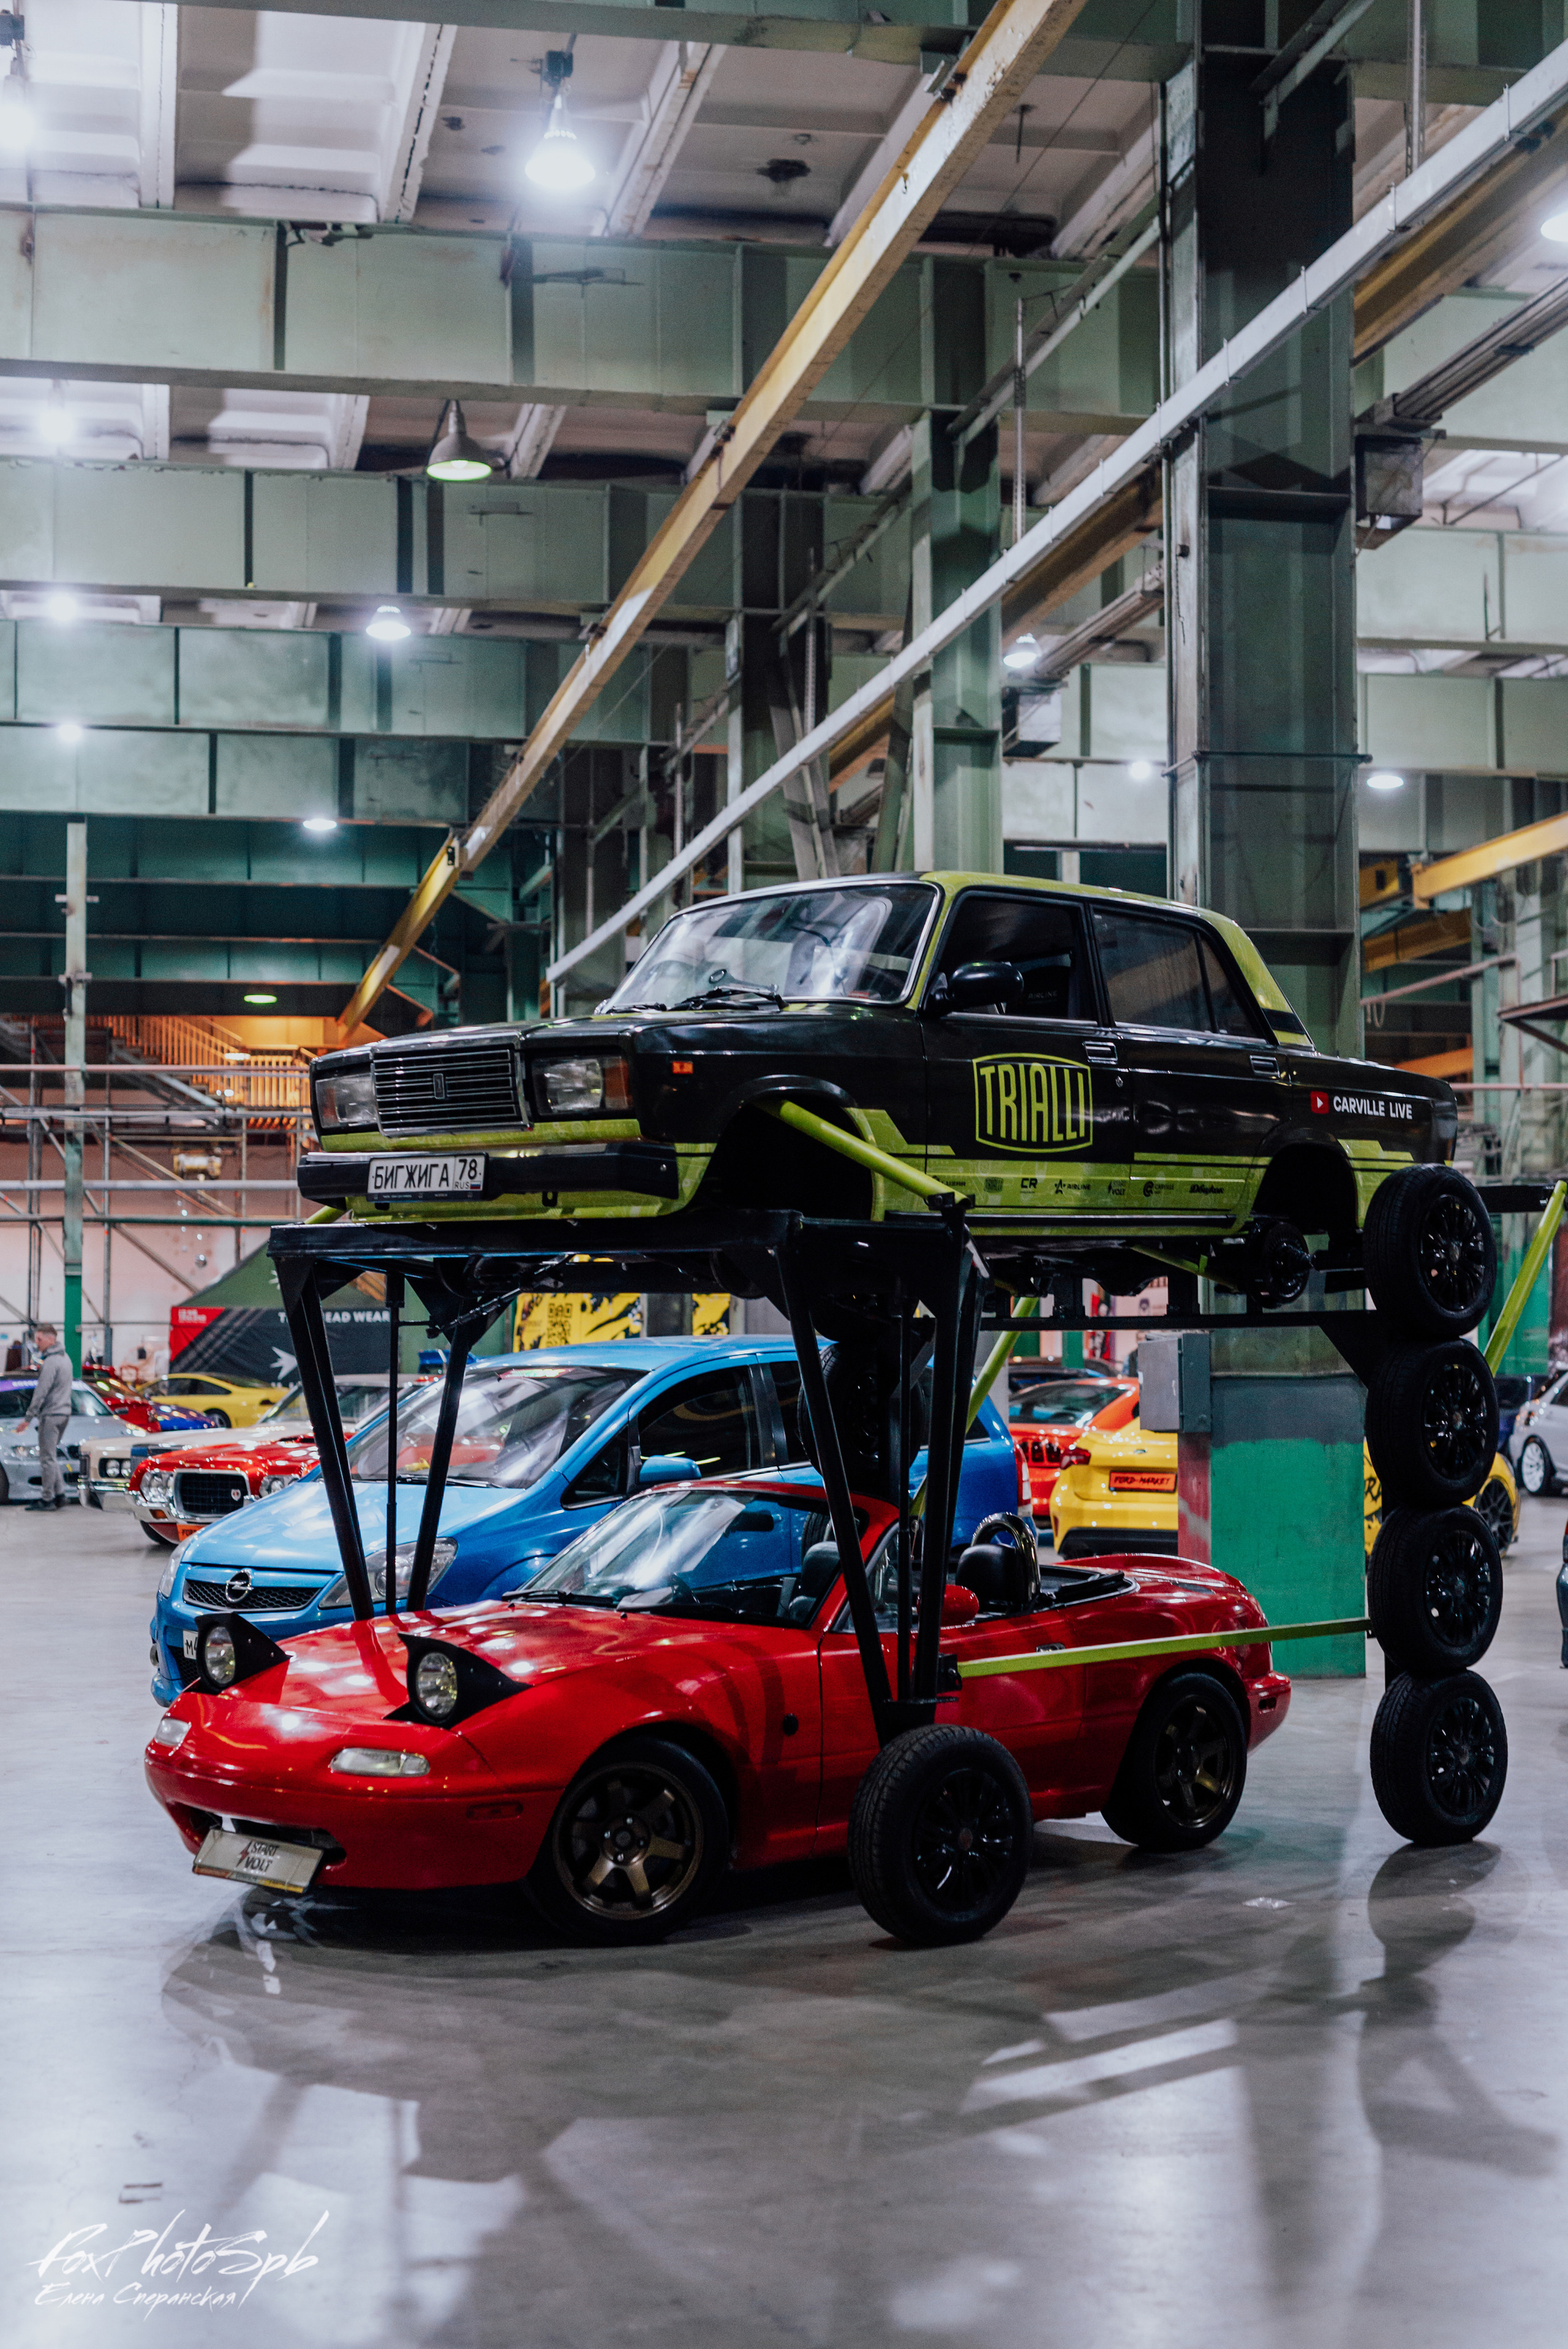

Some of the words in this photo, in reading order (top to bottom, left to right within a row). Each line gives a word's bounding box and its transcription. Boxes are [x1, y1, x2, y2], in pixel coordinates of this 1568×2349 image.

[980, 1062, 1085, 1142] TRIALLI
[1333, 1095, 1385, 1117] CARVILLE
[1389, 1102, 1412, 1120] LIVE
[374, 1163, 449, 1189] БИГЖИГА
[459, 1159, 477, 1180] 78
[454, 1181, 470, 1190] RUS
[1020, 1178, 1038, 1189] CR
[324, 1311, 351, 1323] EAD
[353, 1311, 391, 1323] WEAR
[251, 1842, 279, 1856] START
[245, 1856, 273, 1872] VOLT
